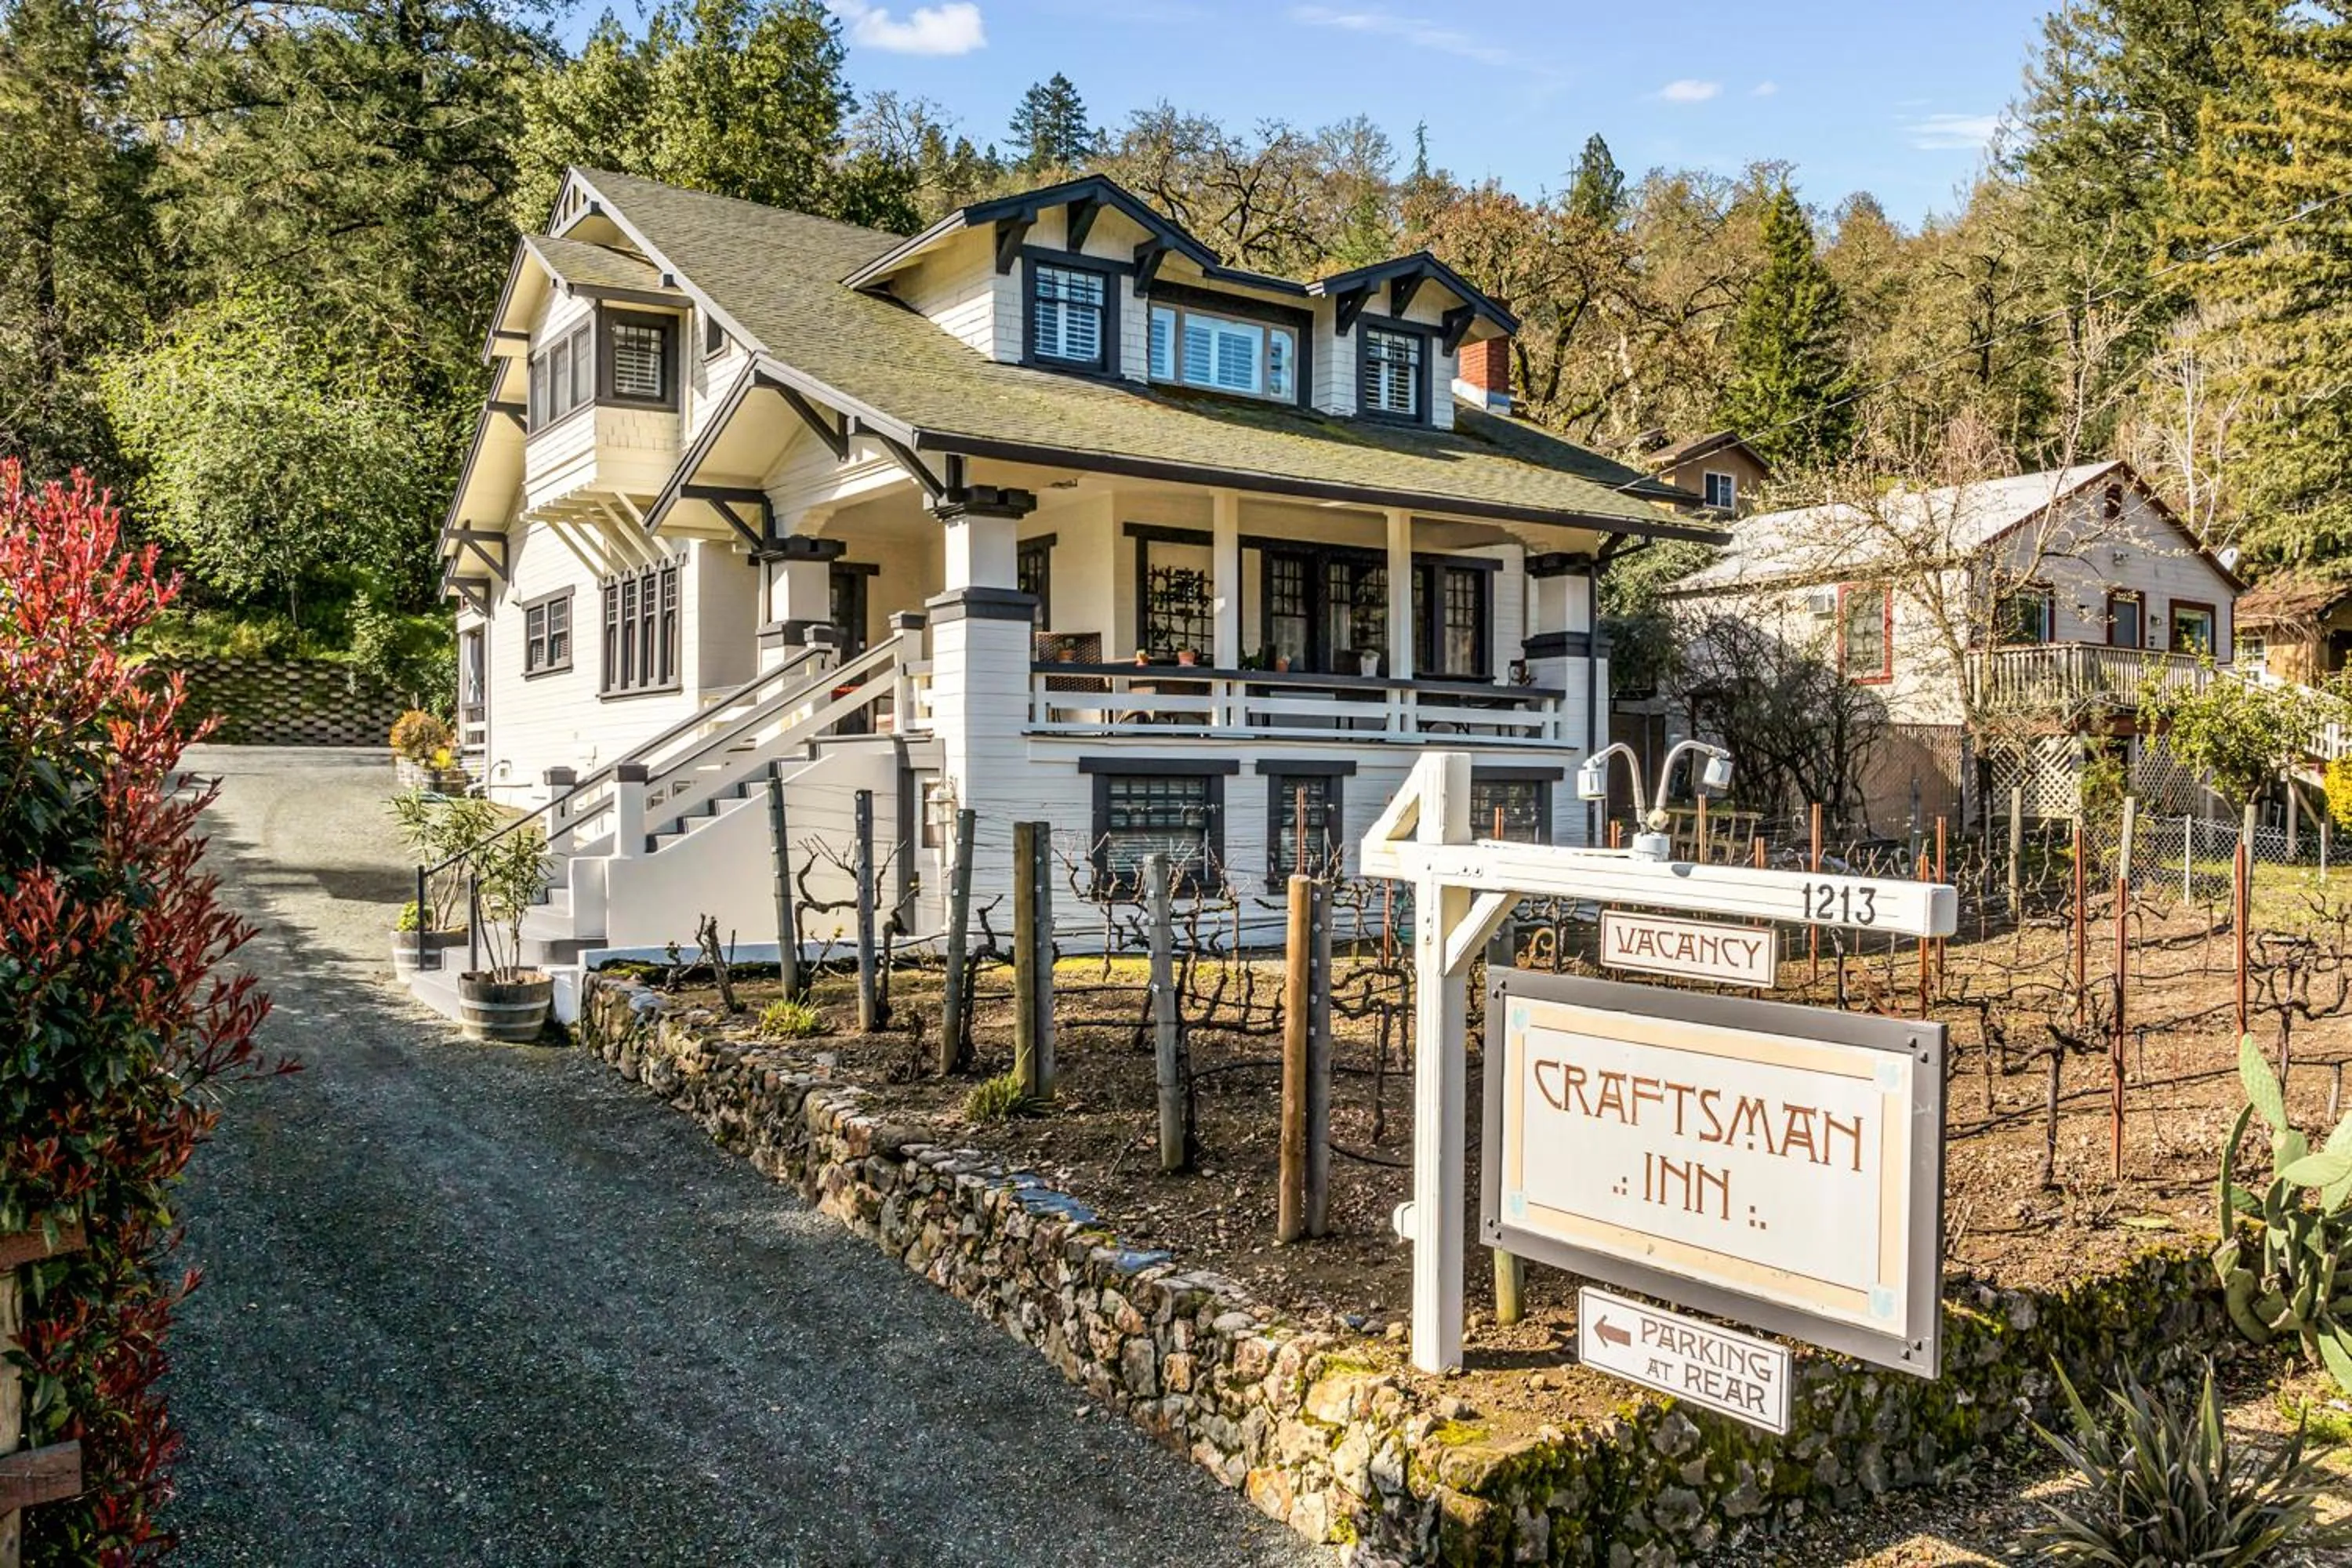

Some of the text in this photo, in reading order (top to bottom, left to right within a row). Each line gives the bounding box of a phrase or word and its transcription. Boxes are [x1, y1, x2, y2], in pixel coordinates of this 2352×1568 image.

[1802, 882, 1877, 926] 1213
[1616, 925, 1762, 970] VACANCY
[1534, 1059, 1864, 1173] CRAFTSMAN
[1643, 1152, 1730, 1221] INN
[1641, 1317, 1773, 1383] PARKING
[1646, 1357, 1767, 1415] AT REAR
